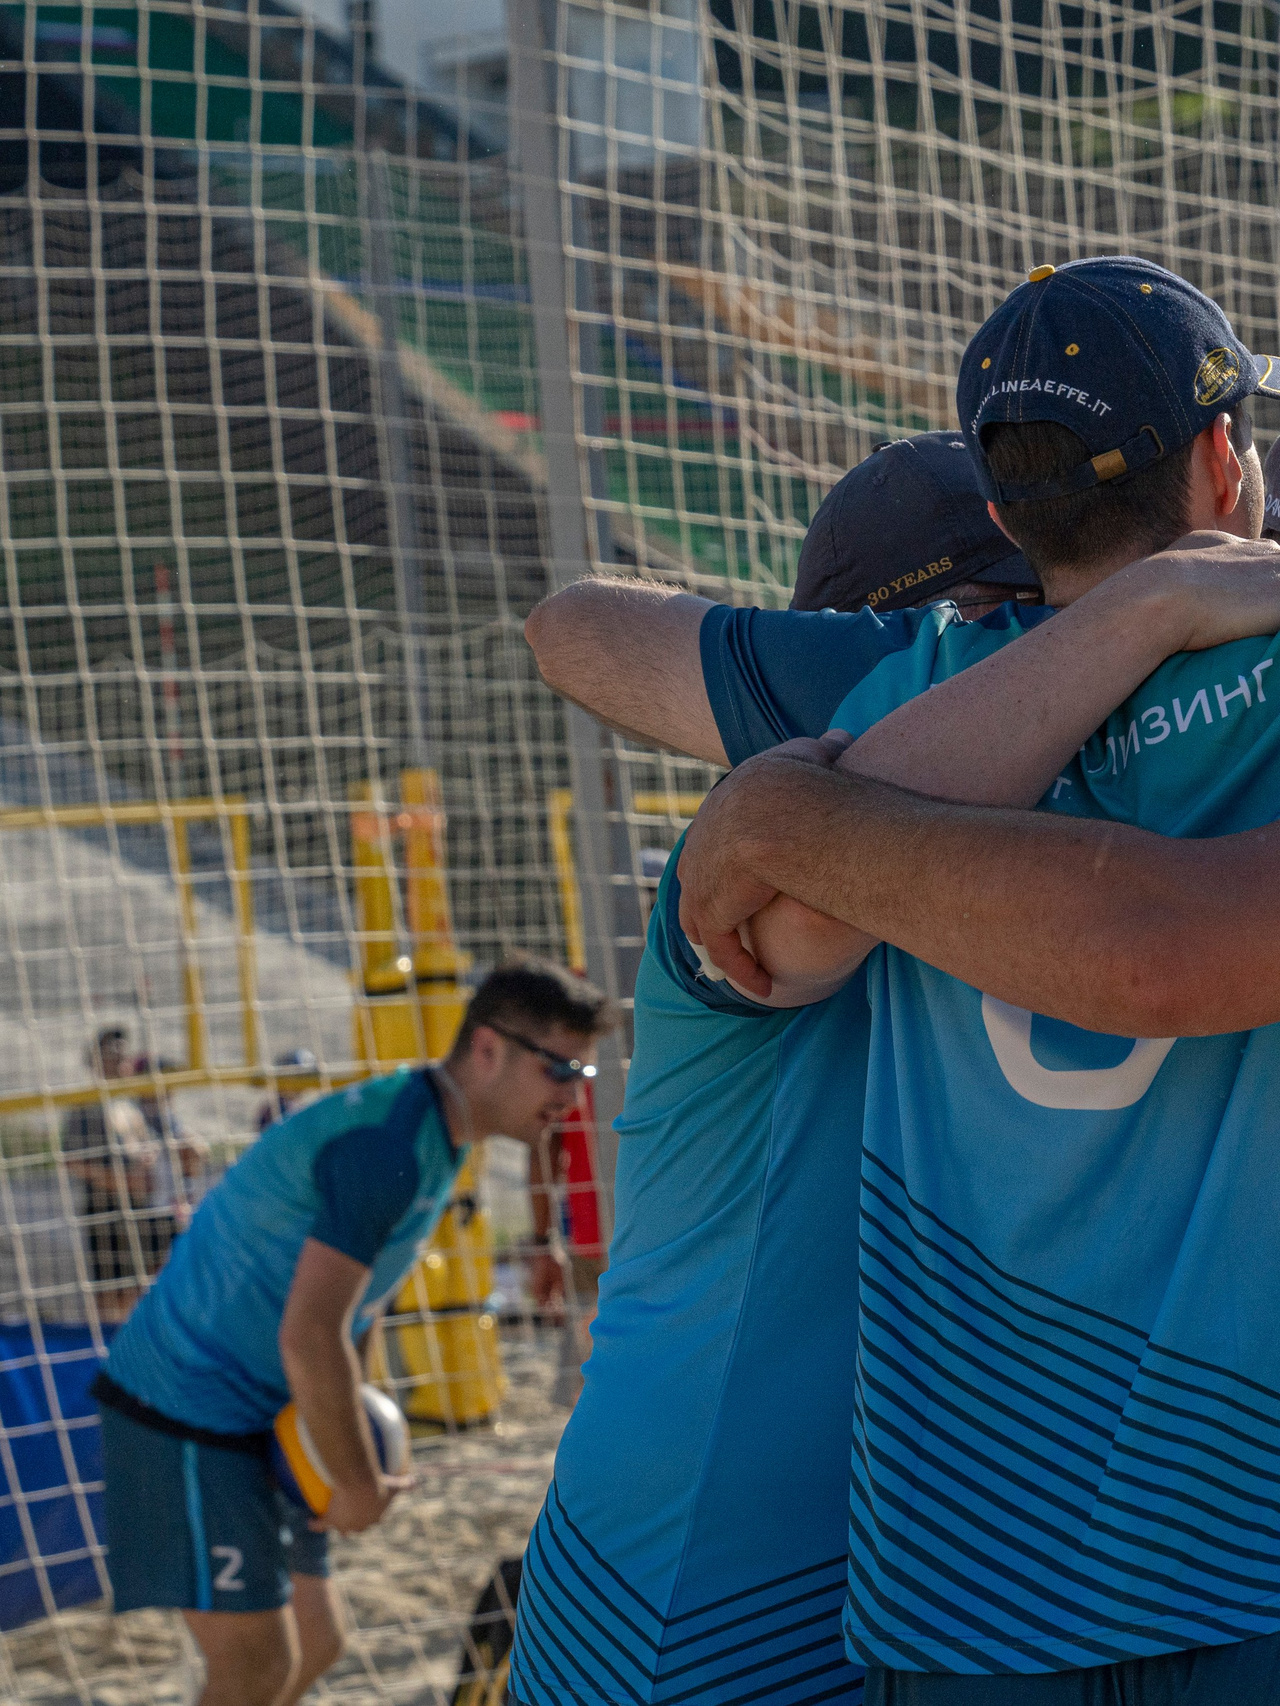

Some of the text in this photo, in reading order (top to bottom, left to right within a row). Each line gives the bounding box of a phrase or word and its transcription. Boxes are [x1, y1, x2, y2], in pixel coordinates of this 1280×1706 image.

[867, 556, 954, 607] 30 YEARS
[211, 1546, 246, 1591] 2
